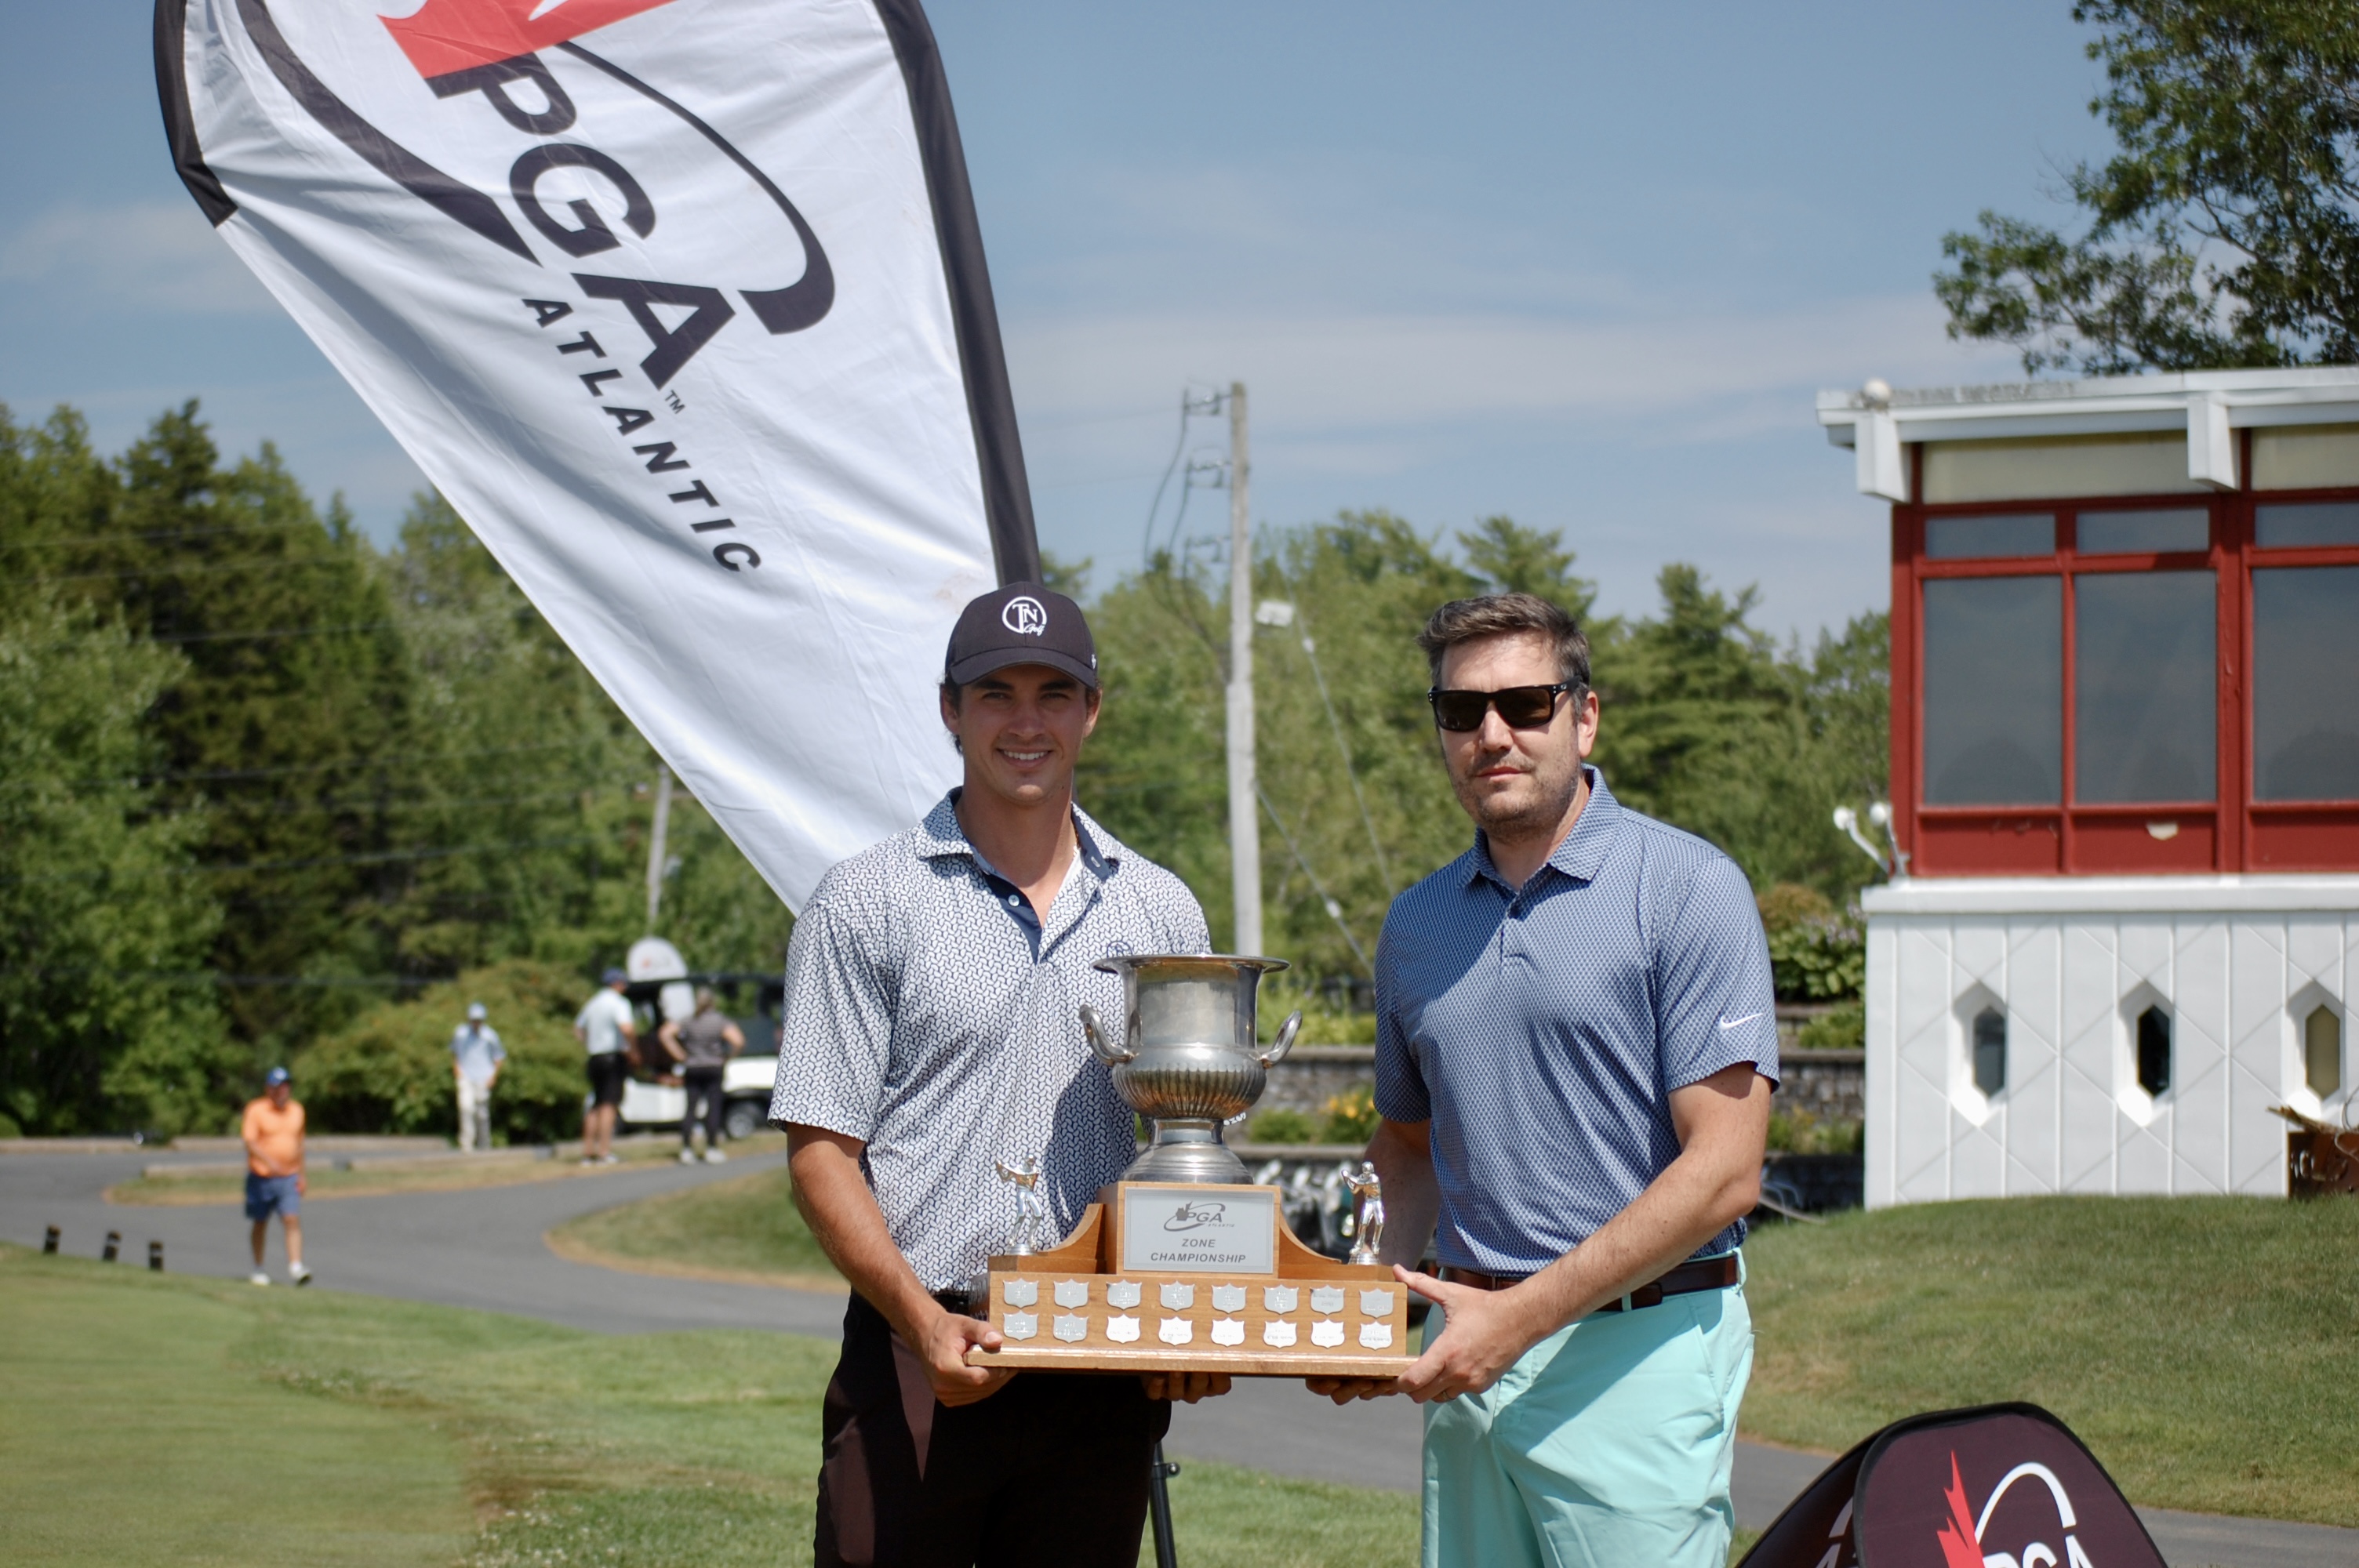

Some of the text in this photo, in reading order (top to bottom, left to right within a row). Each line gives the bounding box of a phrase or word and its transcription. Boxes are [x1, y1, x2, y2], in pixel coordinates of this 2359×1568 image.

[424, 52, 736, 390] PGA
[522, 298, 761, 573] ATLANTIC
[1187, 1212, 1223, 1223] PGA
[1182, 1238, 1216, 1248] ZONE
[1150, 1252, 1246, 1263] CHAMPIONSHIP
